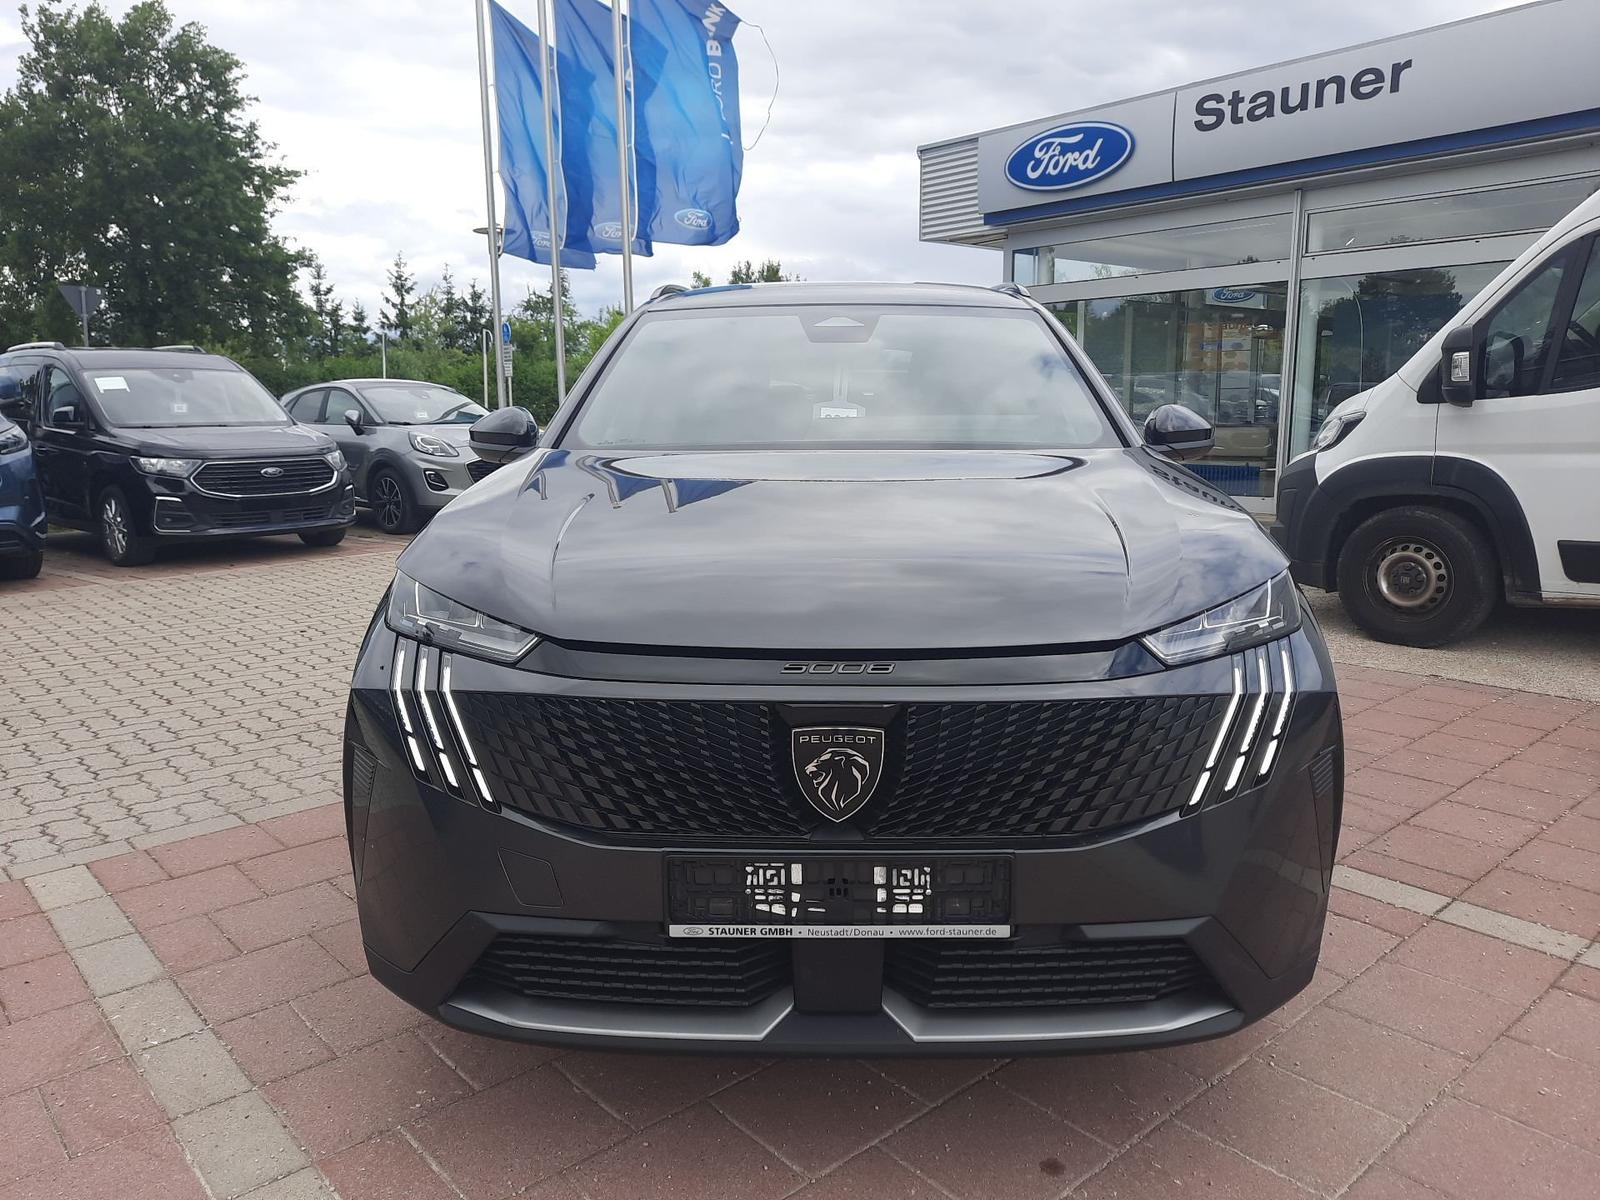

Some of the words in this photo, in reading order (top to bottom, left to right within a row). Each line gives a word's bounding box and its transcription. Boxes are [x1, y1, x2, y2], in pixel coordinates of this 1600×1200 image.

[1193, 58, 1413, 132] Stauner
[1026, 133, 1104, 179] Ford
[684, 211, 709, 227] Ford
[780, 662, 896, 674] 5008
[799, 735, 877, 744] PEUGEOT
[708, 927, 757, 936] STAUNER
[760, 927, 793, 936] GMBH
[807, 928, 885, 938] Neustadt/Donau
[898, 926, 997, 937] www.ford-stauner.de
